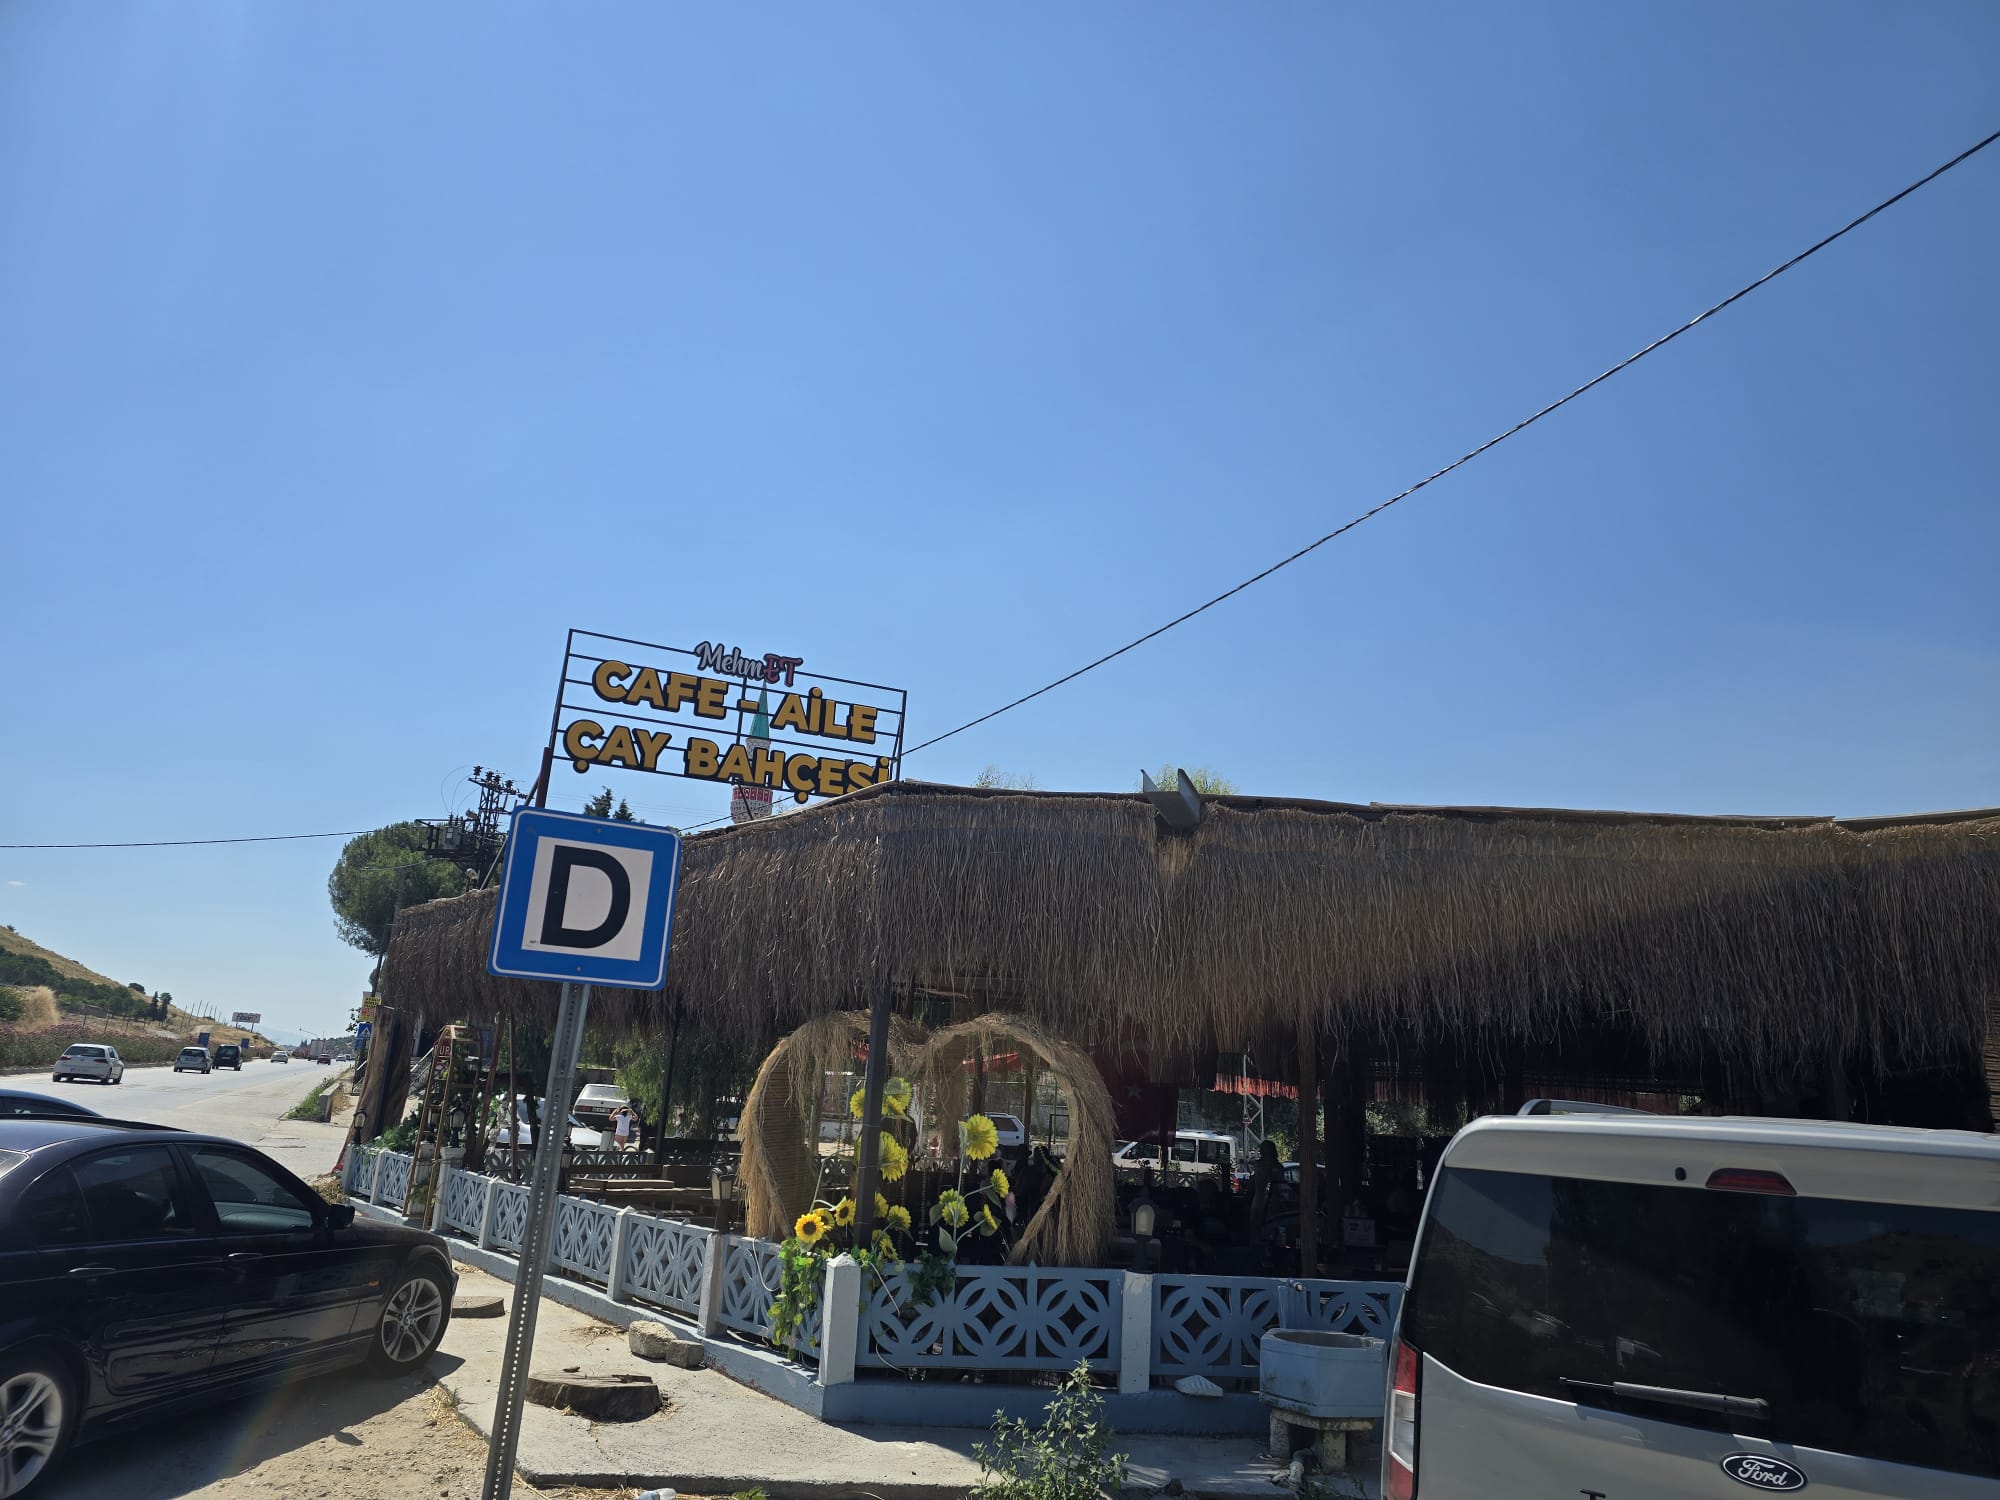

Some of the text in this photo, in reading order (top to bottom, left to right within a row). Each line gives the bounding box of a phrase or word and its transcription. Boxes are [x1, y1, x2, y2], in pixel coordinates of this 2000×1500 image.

[593, 660, 877, 744] CAFE - AİLE
[564, 720, 890, 803] ÇAY BAHÇESİ
[540, 845, 630, 948] D
[1738, 1459, 1788, 1486] Ford
